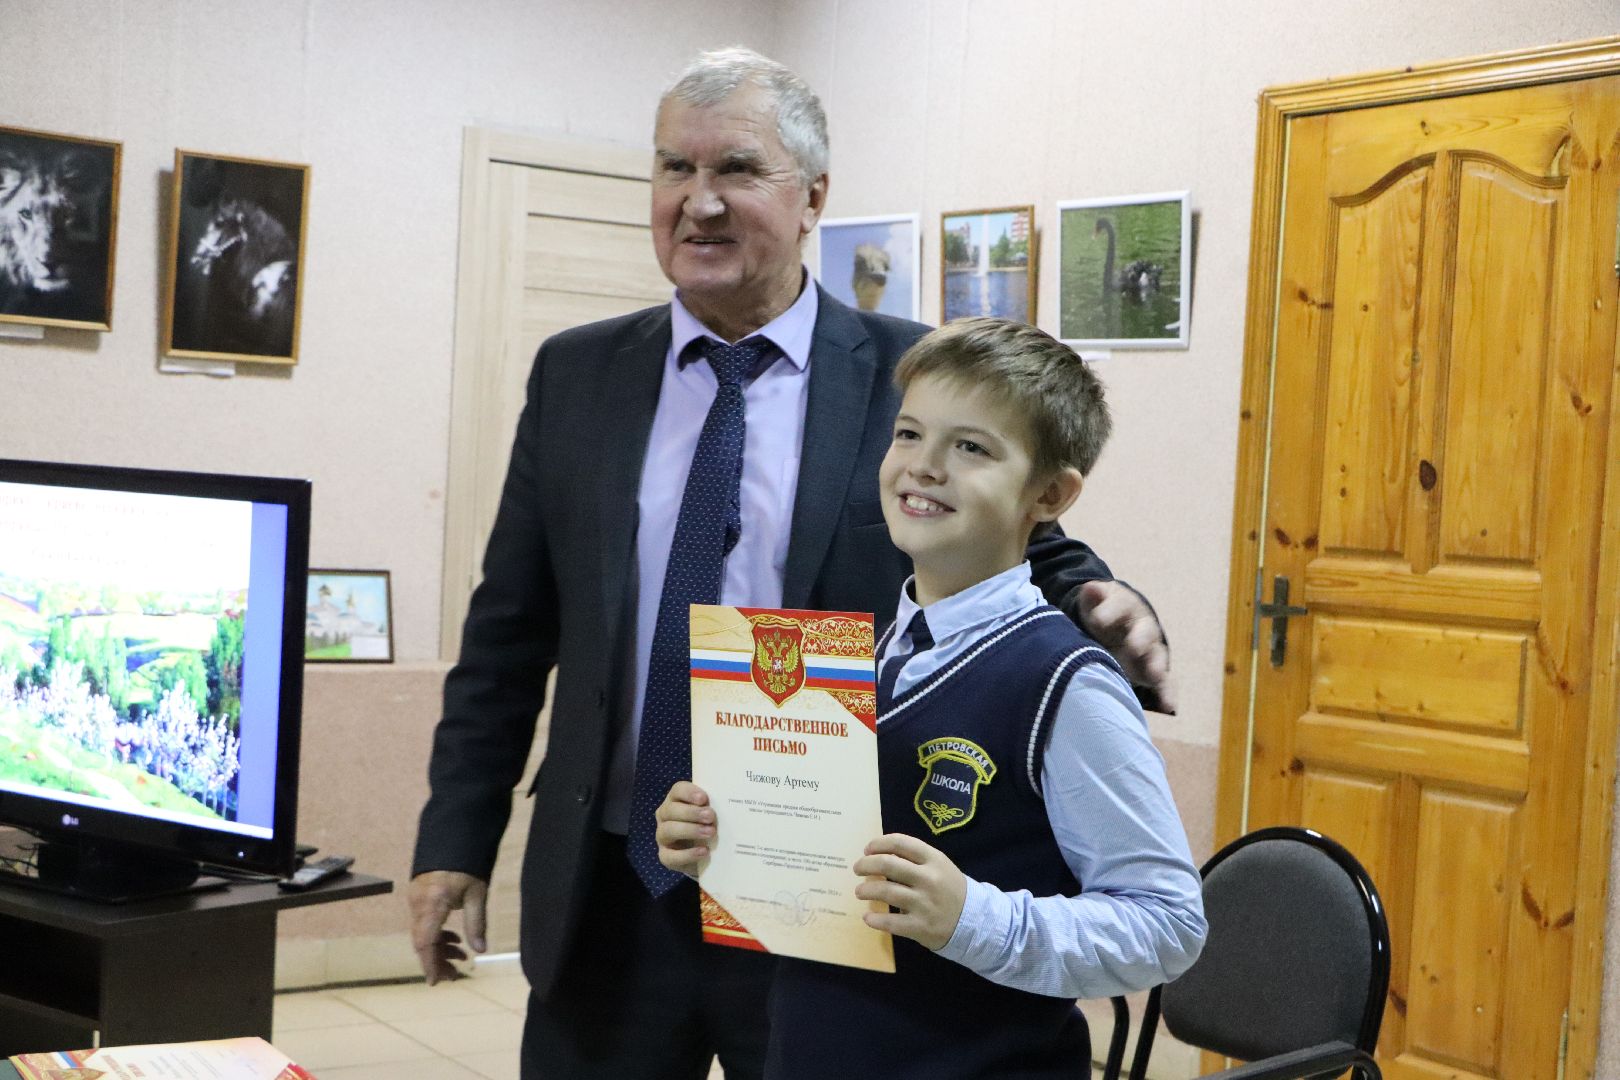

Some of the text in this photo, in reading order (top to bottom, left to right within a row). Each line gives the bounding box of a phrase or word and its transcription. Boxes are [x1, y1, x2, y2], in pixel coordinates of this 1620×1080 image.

[715, 711, 849, 738] БЛАГОДАРСТВЕННОЕ
[753, 737, 808, 756] ПИСЬМО
[928, 741, 989, 768] ПЕТРОВСКАЯ
[746, 770, 820, 792] Чижову Артему
[931, 773, 971, 795] ШКОЛА
